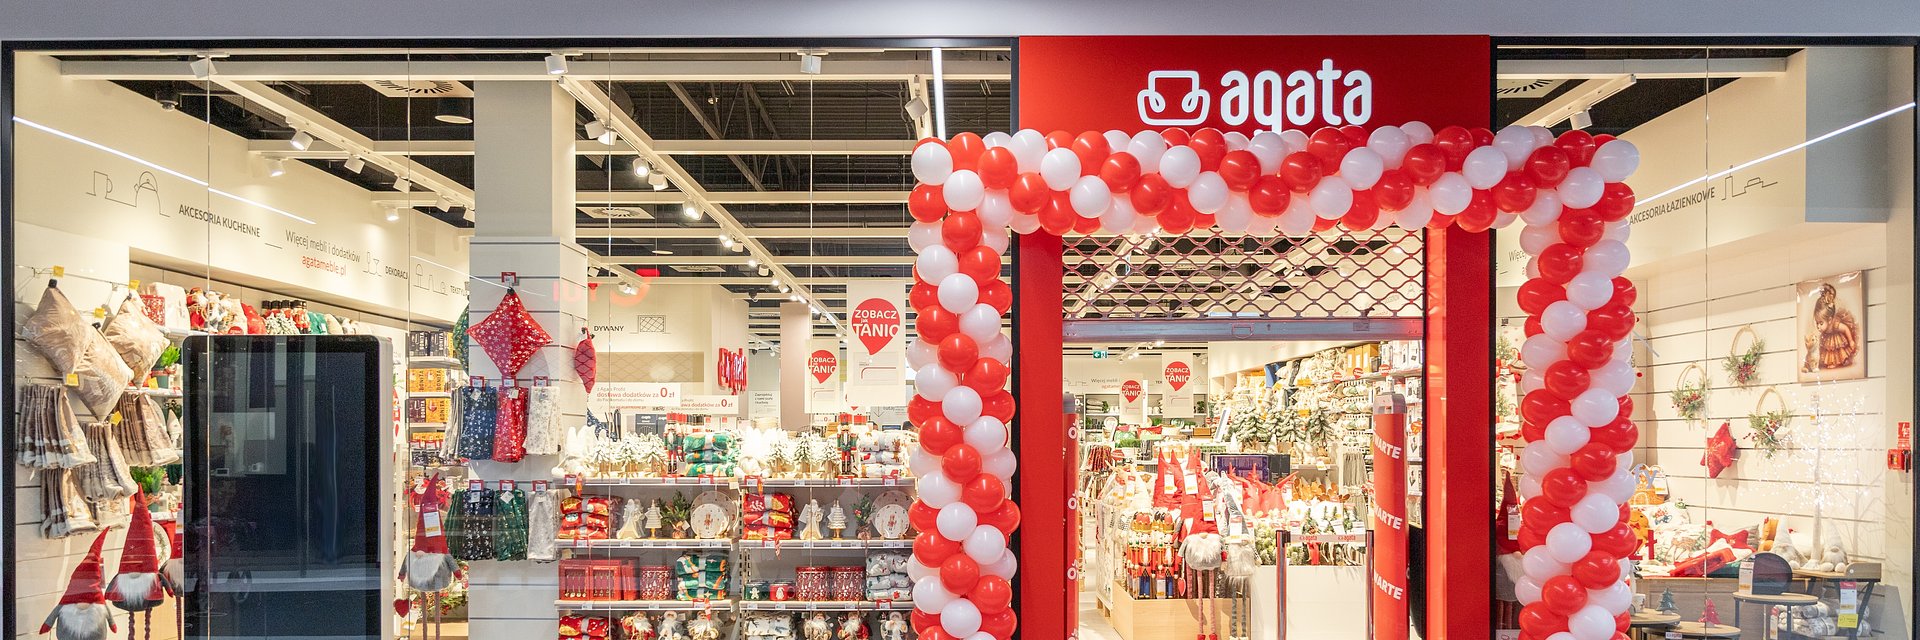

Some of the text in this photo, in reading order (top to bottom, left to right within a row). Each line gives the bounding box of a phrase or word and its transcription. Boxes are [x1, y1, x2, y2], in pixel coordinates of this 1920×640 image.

[1220, 58, 1372, 136] agata
[1629, 187, 1715, 225] AKCESORIA ŁAZIENKOWE
[178, 204, 260, 238] AKCESORIA KUCHENNE
[285, 229, 309, 250] Więcej
[310, 240, 327, 254] mebli
[332, 245, 360, 263] dodatków
[302, 255, 346, 276] agatameble.pl
[854, 309, 897, 320] ZOBACZ
[660, 387, 668, 398] 0
[721, 398, 727, 408] 0
